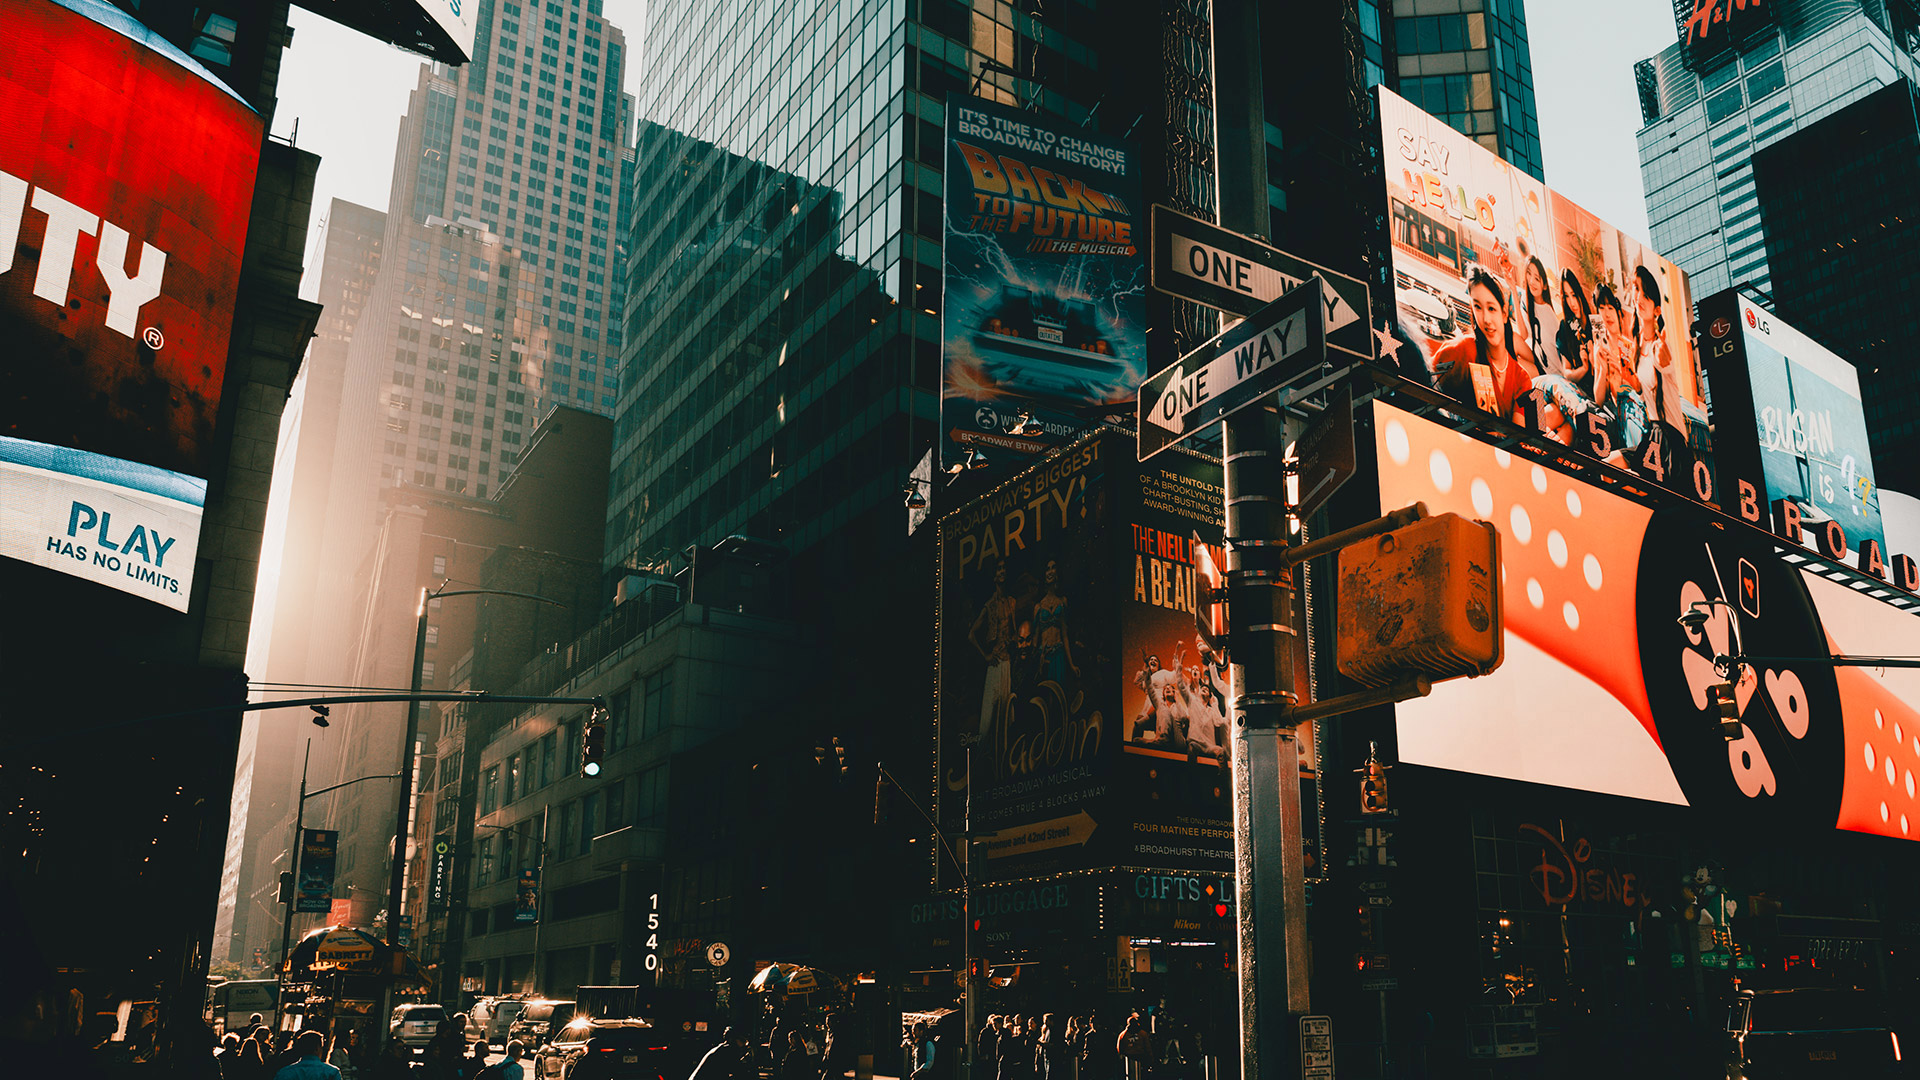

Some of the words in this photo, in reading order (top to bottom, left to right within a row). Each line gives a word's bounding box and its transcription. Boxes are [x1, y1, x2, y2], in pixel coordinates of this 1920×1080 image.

[958, 107, 989, 127] IT'S
[991, 116, 1031, 138] TIME
[1034, 127, 1056, 144] TO
[1060, 136, 1125, 163] CHANGE
[958, 121, 1052, 158] BROADWAY
[1055, 146, 1126, 176] HISTORY!
[1397, 127, 1450, 175] SAY
[956, 141, 1106, 216] BACK
[973, 192, 1010, 217] TO
[1403, 168, 1496, 232] HELLO
[969, 214, 1006, 234] THE
[1009, 202, 1132, 245] FUTURE
[1050, 240, 1077, 252] THE
[1079, 243, 1130, 256] MUSICAL
[1189, 245, 1253, 293] ONE
[1280, 276, 1339, 323] WY
[1757, 318, 1770, 336] LG
[1713, 339, 1734, 359] LG
[1163, 368, 1209, 422] ONE
[1234, 317, 1294, 381] WAY
[1528, 388, 1713, 503] 1540
[1761, 404, 1835, 457] BUSAN
[946, 483, 1032, 541] BROADWAY'S
[1035, 439, 1102, 494] BIGGEST
[1139, 474, 1152, 485] OF
[1153, 479, 1160, 487] A
[1161, 481, 1207, 501] BROOKLYN
[1207, 494, 1221, 505] KID
[1142, 486, 1212, 514] CHART-BUSTING,
[1213, 506, 1225, 517] SH
[1160, 469, 1178, 482] THE
[1179, 474, 1214, 492] UNTOLD
[1214, 485, 1225, 496] TR
[1819, 463, 1835, 504] is
[959, 474, 1088, 580] PARTY!
[1143, 498, 1214, 525] AWARD-WINNING
[68, 501, 176, 567] PLAY
[1131, 522, 1155, 555] THE
[1157, 529, 1188, 564] NEIL
[46, 536, 87, 562] HAS
[93, 548, 121, 574] NO
[126, 556, 179, 596] LIMITS
[1134, 553, 1147, 604] A
[1150, 558, 1195, 616] BEAU
[946, 680, 1104, 793] Aladdin
[992, 778, 1045, 799] BROADWAY
[1047, 765, 1093, 784] MUSICAL
[988, 807, 1014, 821] COMES
[1015, 801, 1036, 815] TRUE
[1038, 801, 1044, 809] 4
[1047, 792, 1079, 809] BLOCKS
[1082, 785, 1107, 800] AWAY
[1176, 816, 1189, 824] THE
[1190, 817, 1206, 825] ONLY
[1207, 818, 1233, 828] BROADW
[987, 838, 1011, 851] Avenue
[1013, 834, 1026, 846] and
[1028, 830, 1046, 844] 42nd
[1047, 826, 1070, 841] Street
[1133, 823, 1158, 833] FOUR
[1160, 825, 1200, 837] MATINEE
[1201, 828, 1234, 840] PERFOR
[1140, 845, 1198, 857] BROADHURST
[1198, 849, 1235, 860] THEATRE
[434, 855, 445, 898] PARKING
[1135, 875, 1201, 902] GIFTS
[910, 898, 960, 924] GIFTS
[974, 884, 1069, 917] LUGGAGE
[644, 893, 659, 973] 1540
[985, 931, 1012, 942] SONY
[1174, 919, 1201, 930] Nikon
[320, 950, 372, 960] SABRETT
[1120, 958, 1129, 988] ATM
